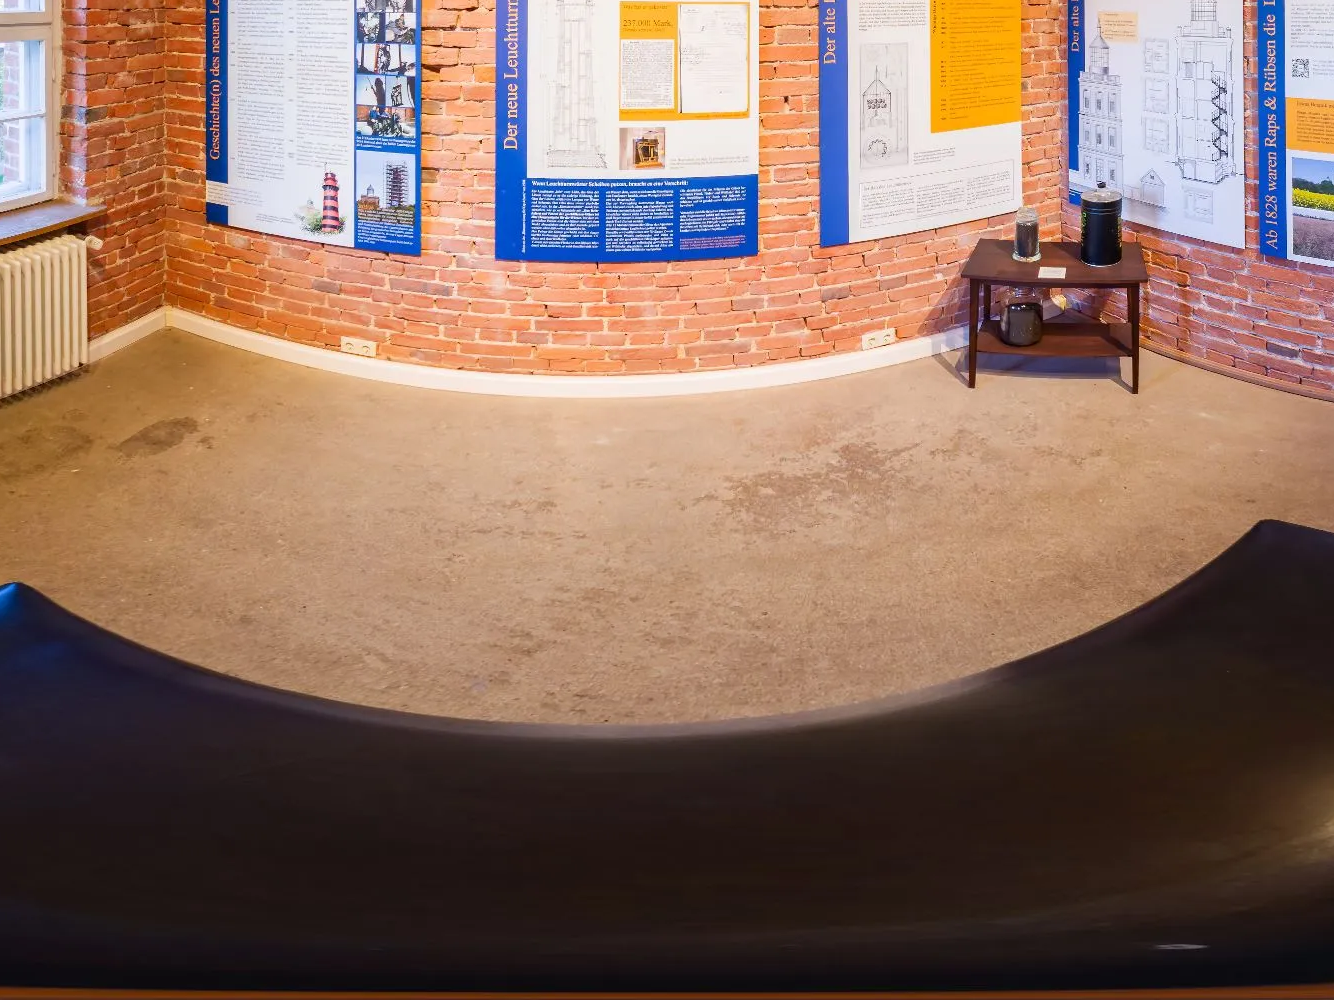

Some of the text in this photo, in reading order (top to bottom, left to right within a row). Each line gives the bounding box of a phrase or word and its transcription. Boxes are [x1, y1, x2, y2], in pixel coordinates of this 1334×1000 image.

[823, 7, 835, 33] alte
[1071, 5, 1079, 27] alte
[1263, 14, 1276, 36] die
[212, 18, 220, 57] neuen
[1071, 31, 1079, 52] Der
[824, 39, 836, 64] Der
[210, 61, 220, 77] des
[1264, 40, 1276, 92] Rübsen
[507, 84, 518, 119] neue
[1264, 96, 1276, 110] &
[210, 79, 222, 160] Geschichte(n)
[1265, 114, 1280, 148] Raps
[504, 123, 518, 150] Der
[1268, 152, 1277, 191] waren
[1265, 195, 1278, 225] 1828
[1265, 229, 1278, 249] Ab
